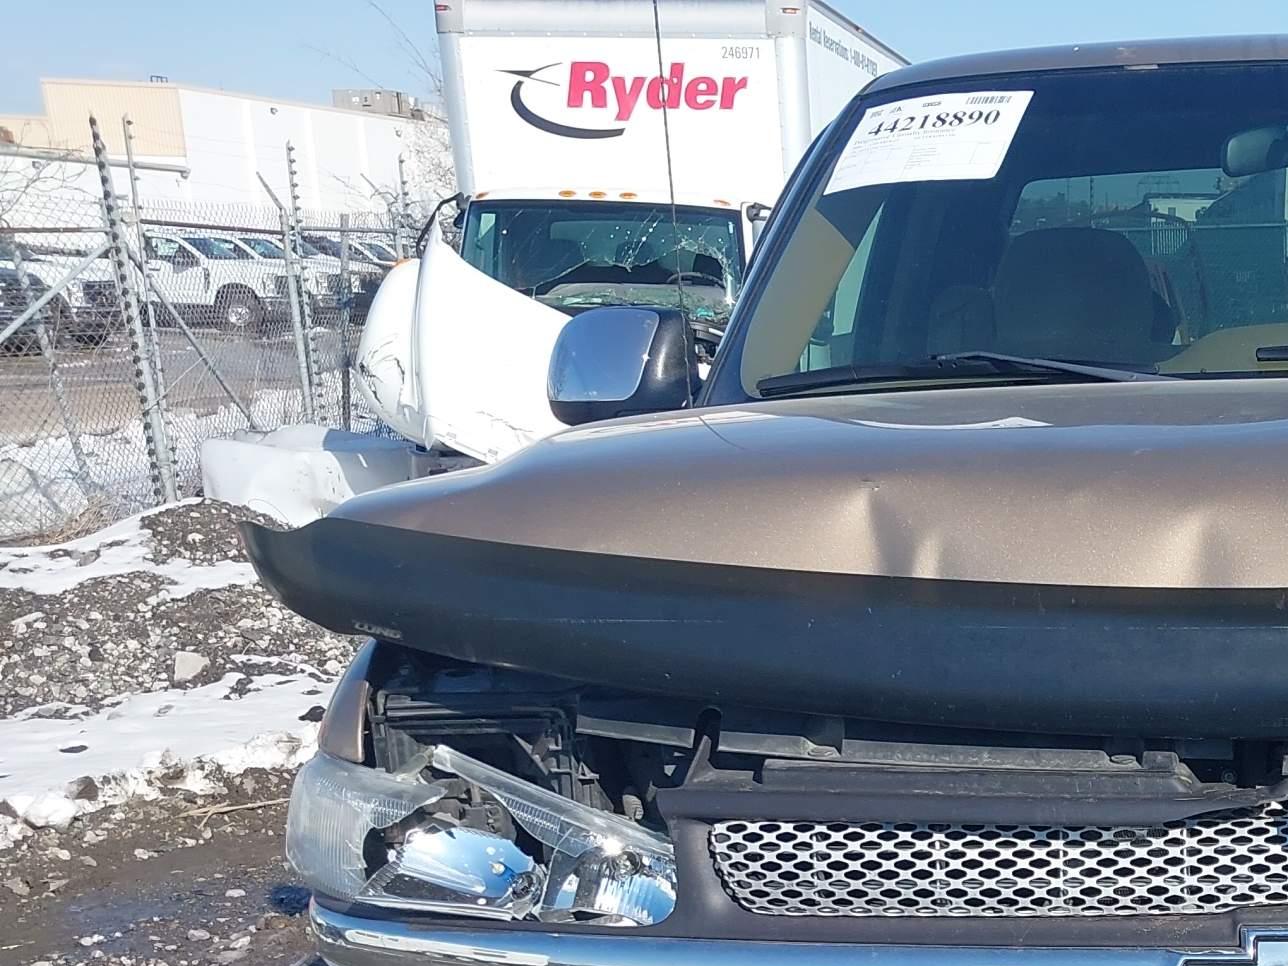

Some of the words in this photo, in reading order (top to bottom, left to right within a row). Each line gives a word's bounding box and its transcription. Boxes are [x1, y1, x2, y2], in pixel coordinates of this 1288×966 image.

[721, 46, 760, 59] 246971
[567, 61, 748, 121] Ryder
[868, 109, 1001, 136] 44218890
